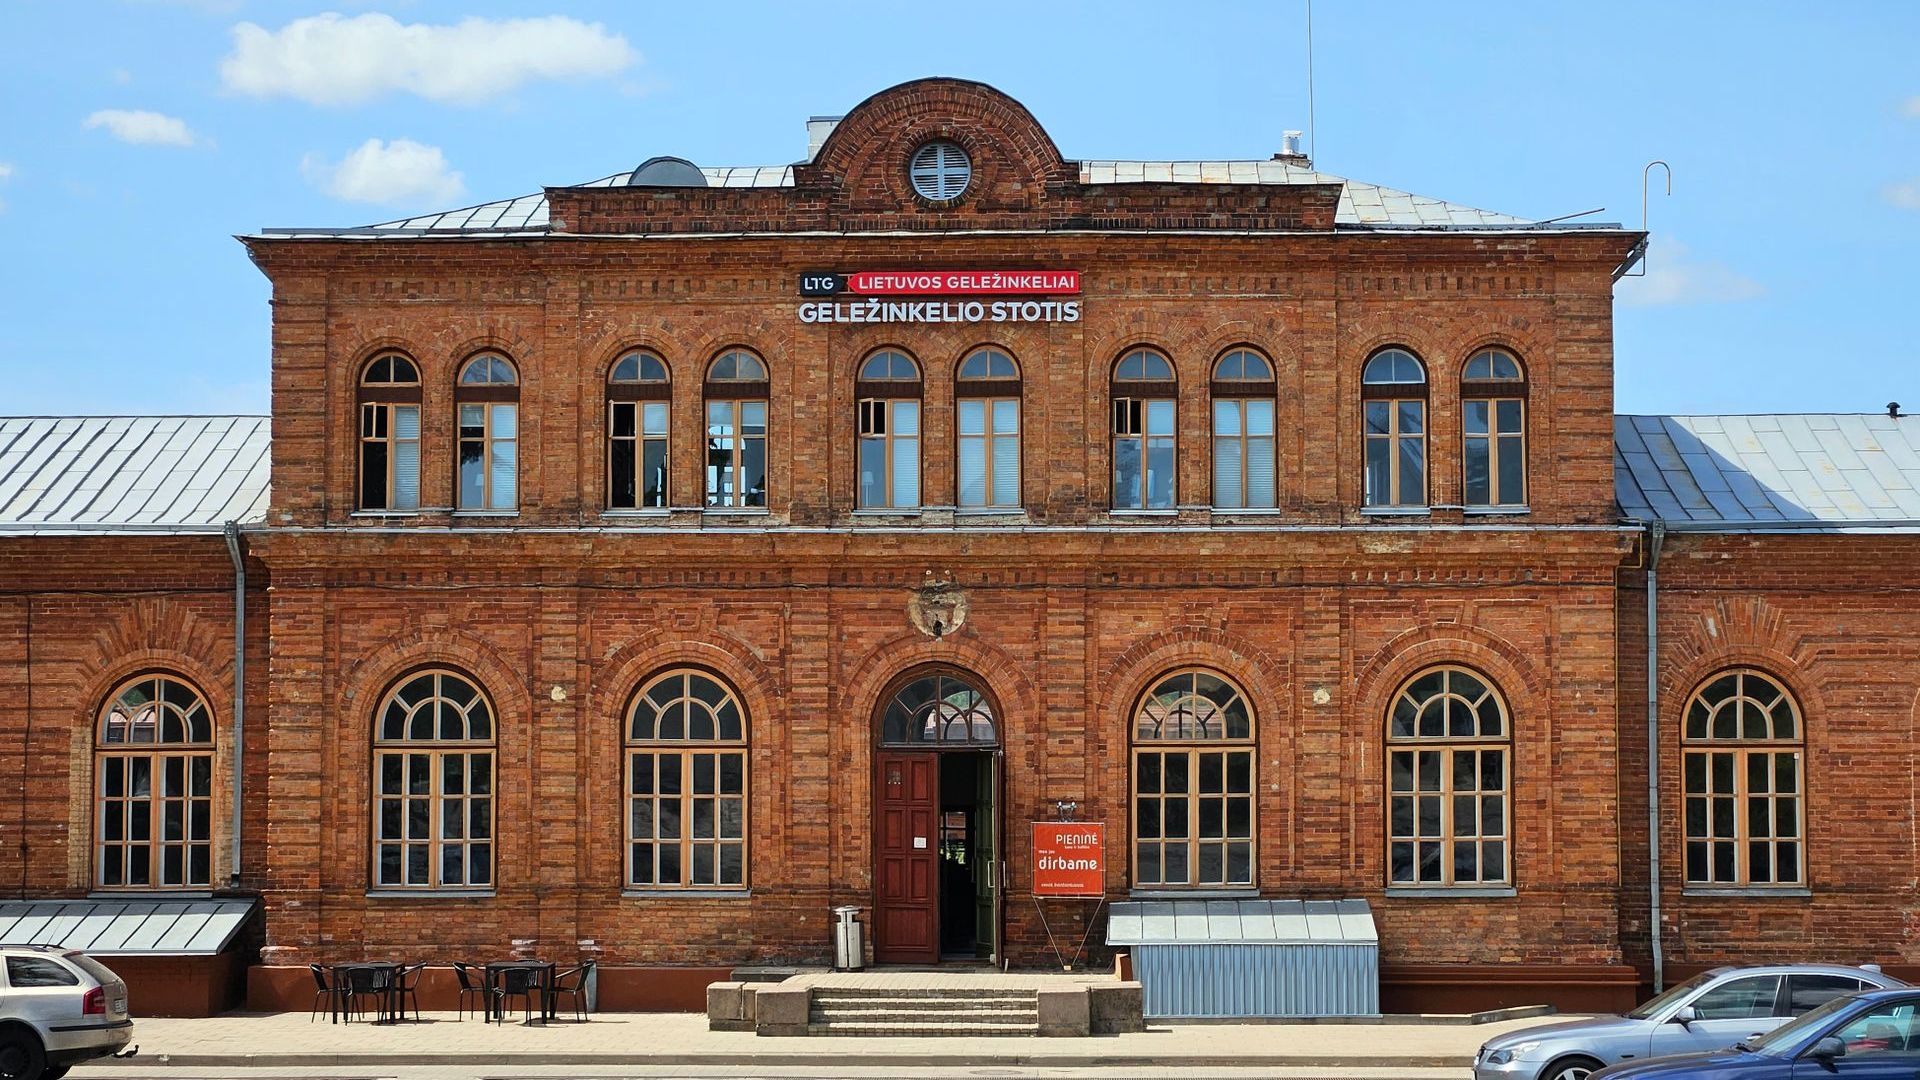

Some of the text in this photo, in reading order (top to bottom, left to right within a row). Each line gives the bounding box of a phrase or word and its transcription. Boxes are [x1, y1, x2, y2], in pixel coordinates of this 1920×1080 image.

[804, 273, 1075, 290] LTG LIETUVOS GELEŽINKELIAI
[798, 298, 1079, 323] GELEŽINKELIO STOTIS
[1055, 832, 1098, 845] PIENINĖ
[1038, 856, 1098, 870] dirbame
